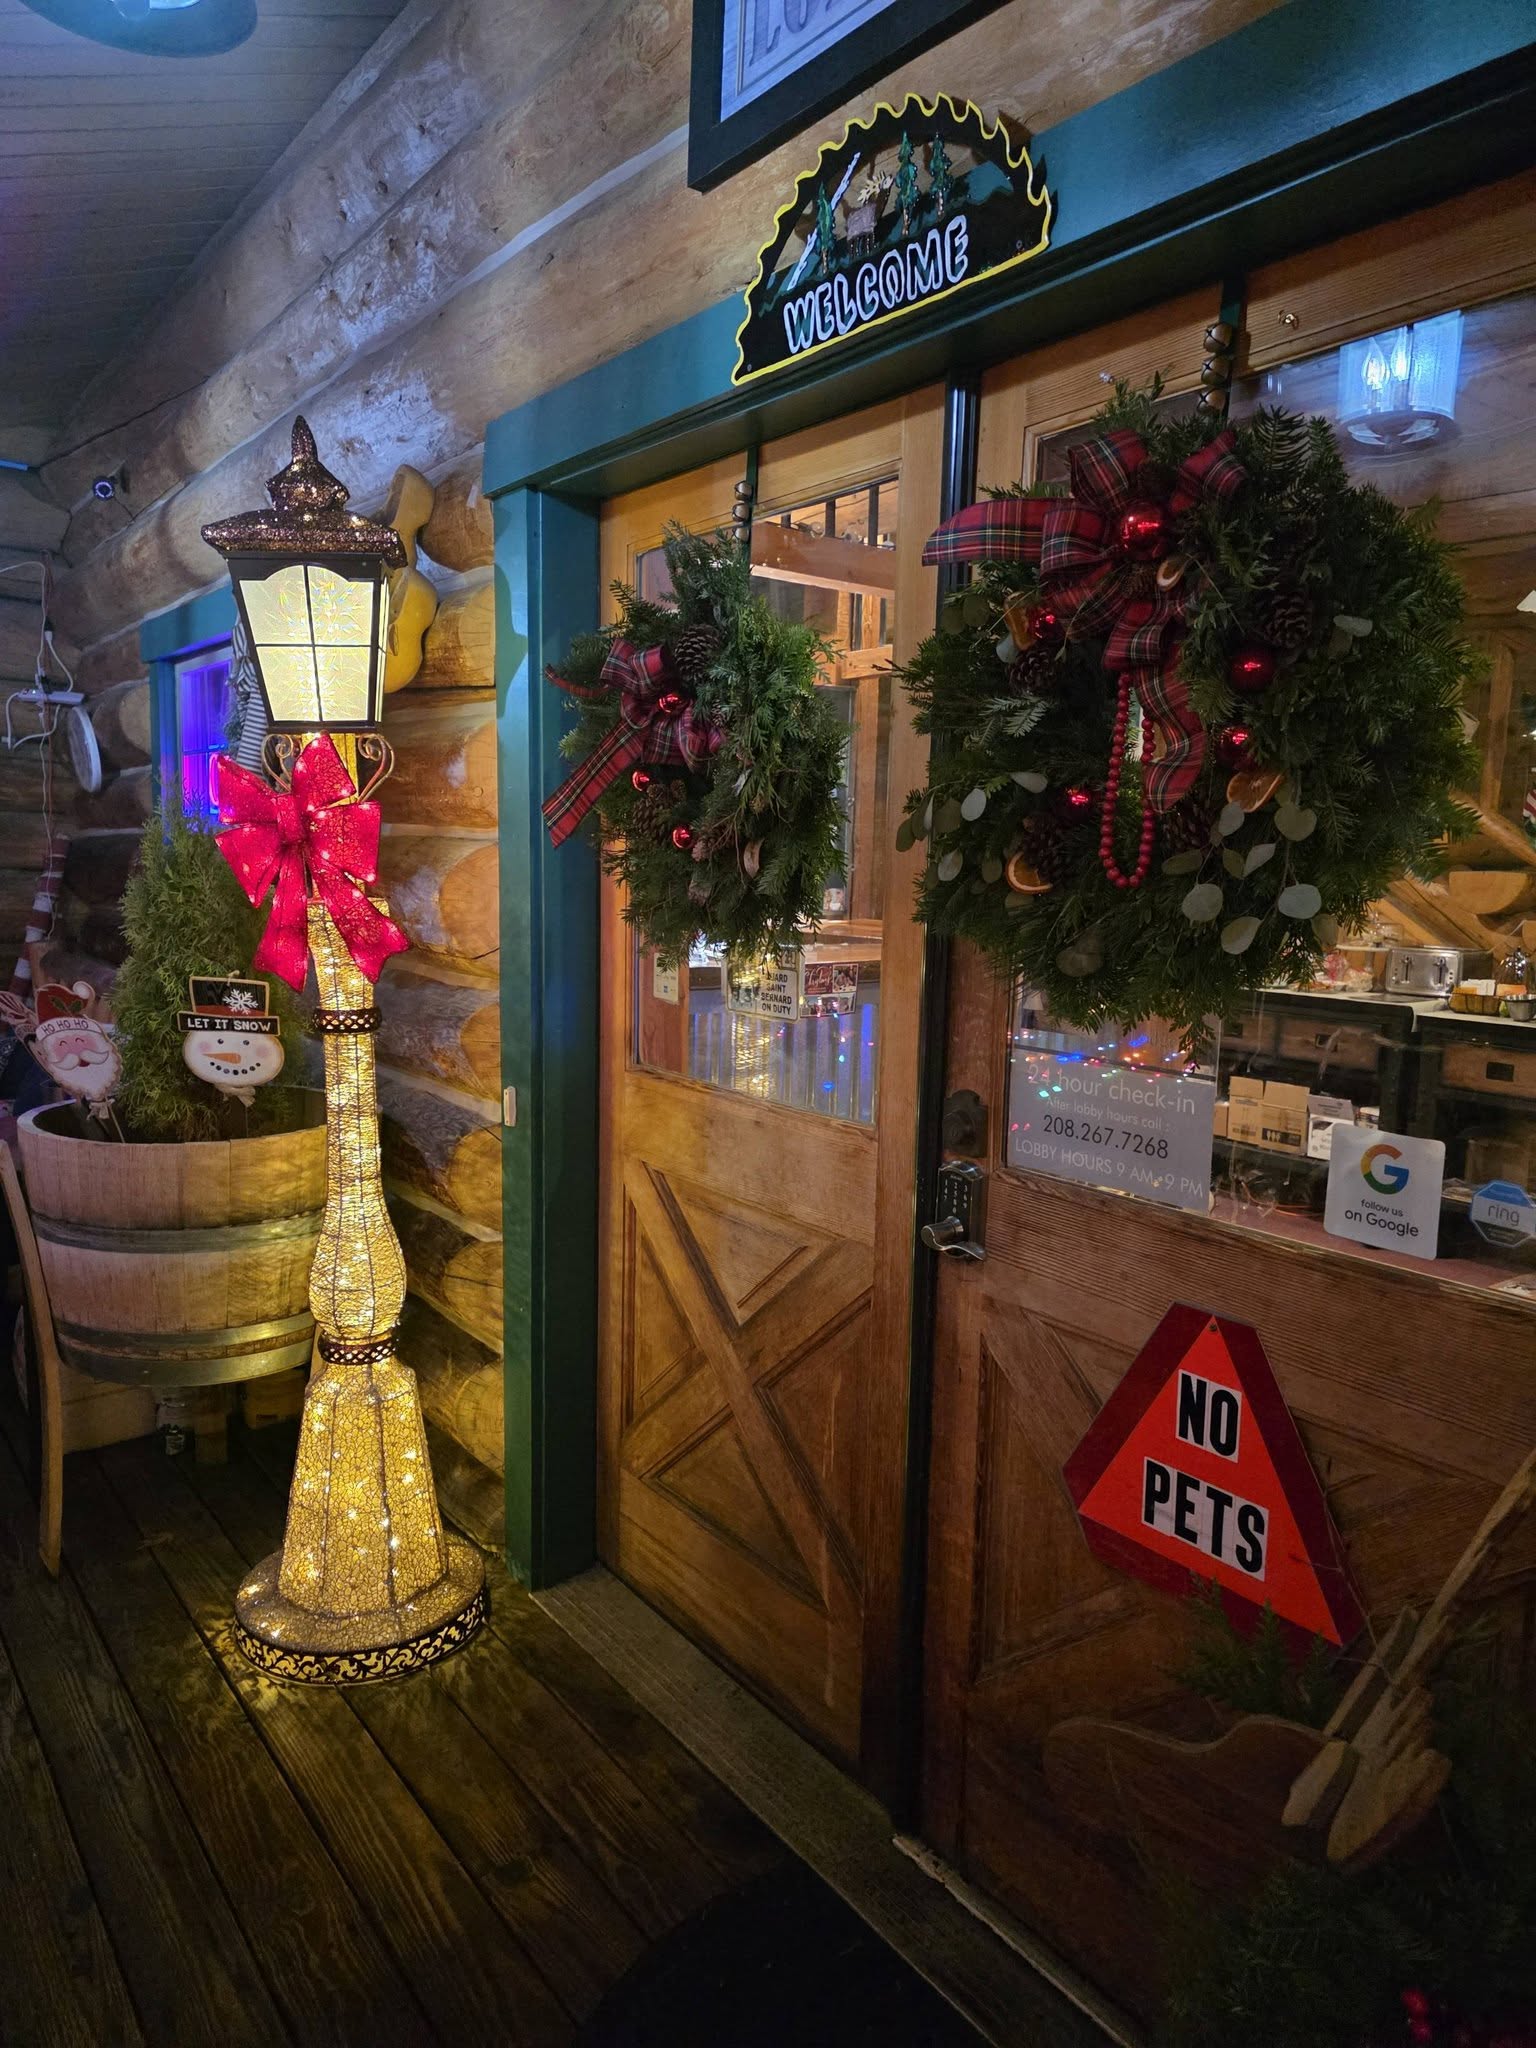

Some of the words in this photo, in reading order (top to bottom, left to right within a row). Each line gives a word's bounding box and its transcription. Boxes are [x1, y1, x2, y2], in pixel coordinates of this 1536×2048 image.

[784, 215, 969, 354] WELCOME
[761, 992, 792, 1005] BERNARD
[767, 982, 786, 993] SAINT
[762, 1003, 771, 1012] ON
[773, 1005, 791, 1015] DUTY
[41, 1023, 55, 1035] HO
[56, 1019, 71, 1030] HO
[74, 1019, 89, 1030] HO
[187, 1018, 209, 1029] LET
[215, 1019, 228, 1030] IT
[233, 1020, 271, 1032] SNOW
[1058, 1067, 1102, 1097] hour
[1109, 1079, 1195, 1114] check-in
[1073, 1100, 1103, 1120] lobby
[1106, 1105, 1138, 1125] hours
[1043, 1114, 1168, 1159] 208.267.7268
[1015, 1137, 1057, 1161] LOBBY
[1062, 1148, 1112, 1175] HOURS
[1117, 1162, 1125, 1177] 9
[1181, 1177, 1203, 1198] PM
[1361, 1199, 1389, 1213] follow
[1391, 1208, 1404, 1217] us
[1488, 1205, 1520, 1227] ring
[1345, 1210, 1362, 1222] on
[1366, 1212, 1419, 1237] Google
[1178, 1372, 1240, 1457] NO
[1143, 1458, 1266, 1574] PETS
